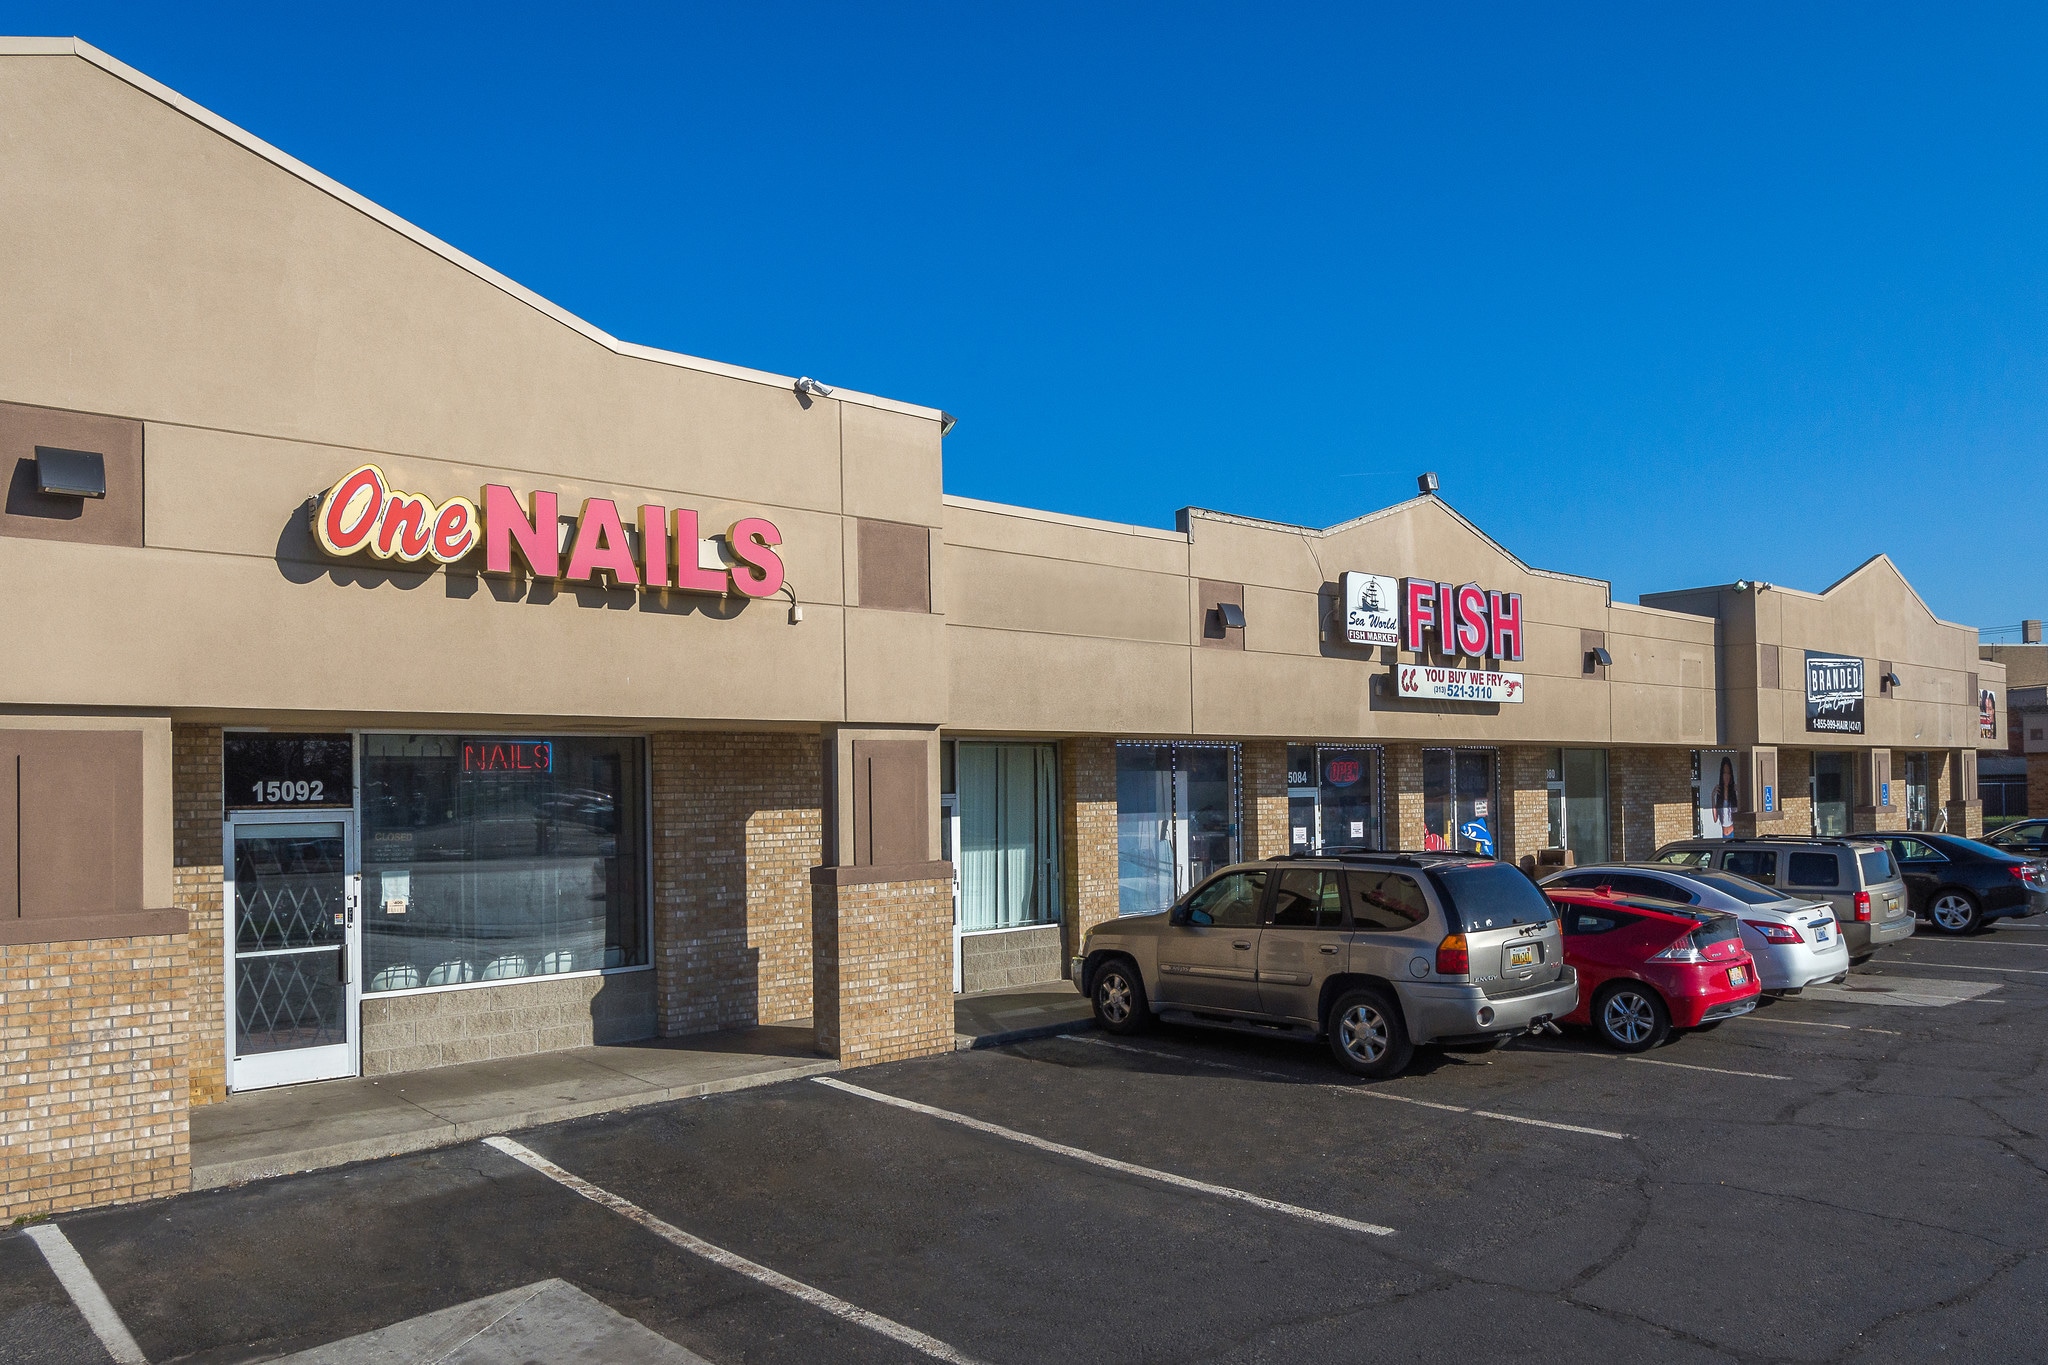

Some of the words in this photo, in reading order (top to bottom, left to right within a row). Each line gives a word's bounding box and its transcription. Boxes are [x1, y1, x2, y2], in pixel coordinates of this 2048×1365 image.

[319, 465, 480, 562] One
[481, 484, 785, 598] NAILS
[1349, 611, 1366, 627] Sea
[1368, 614, 1397, 630] World
[1406, 577, 1523, 661] FISH
[1349, 630, 1366, 641] FISH
[1367, 631, 1397, 643] MARKET
[1425, 668, 1445, 683] YOU
[1448, 670, 1467, 684] BUY
[1470, 672, 1485, 686] WE
[1486, 673, 1504, 687] FRY
[1811, 668, 1859, 691] BRANDED
[1433, 685, 1446, 695] (313)
[1446, 684, 1493, 699] 521-3110
[465, 745, 549, 770] NAILS
[1288, 771, 1308, 784] 5084
[1329, 761, 1359, 783] OPEN
[252, 780, 324, 802] 15092
[374, 832, 413, 841] CLOSED
